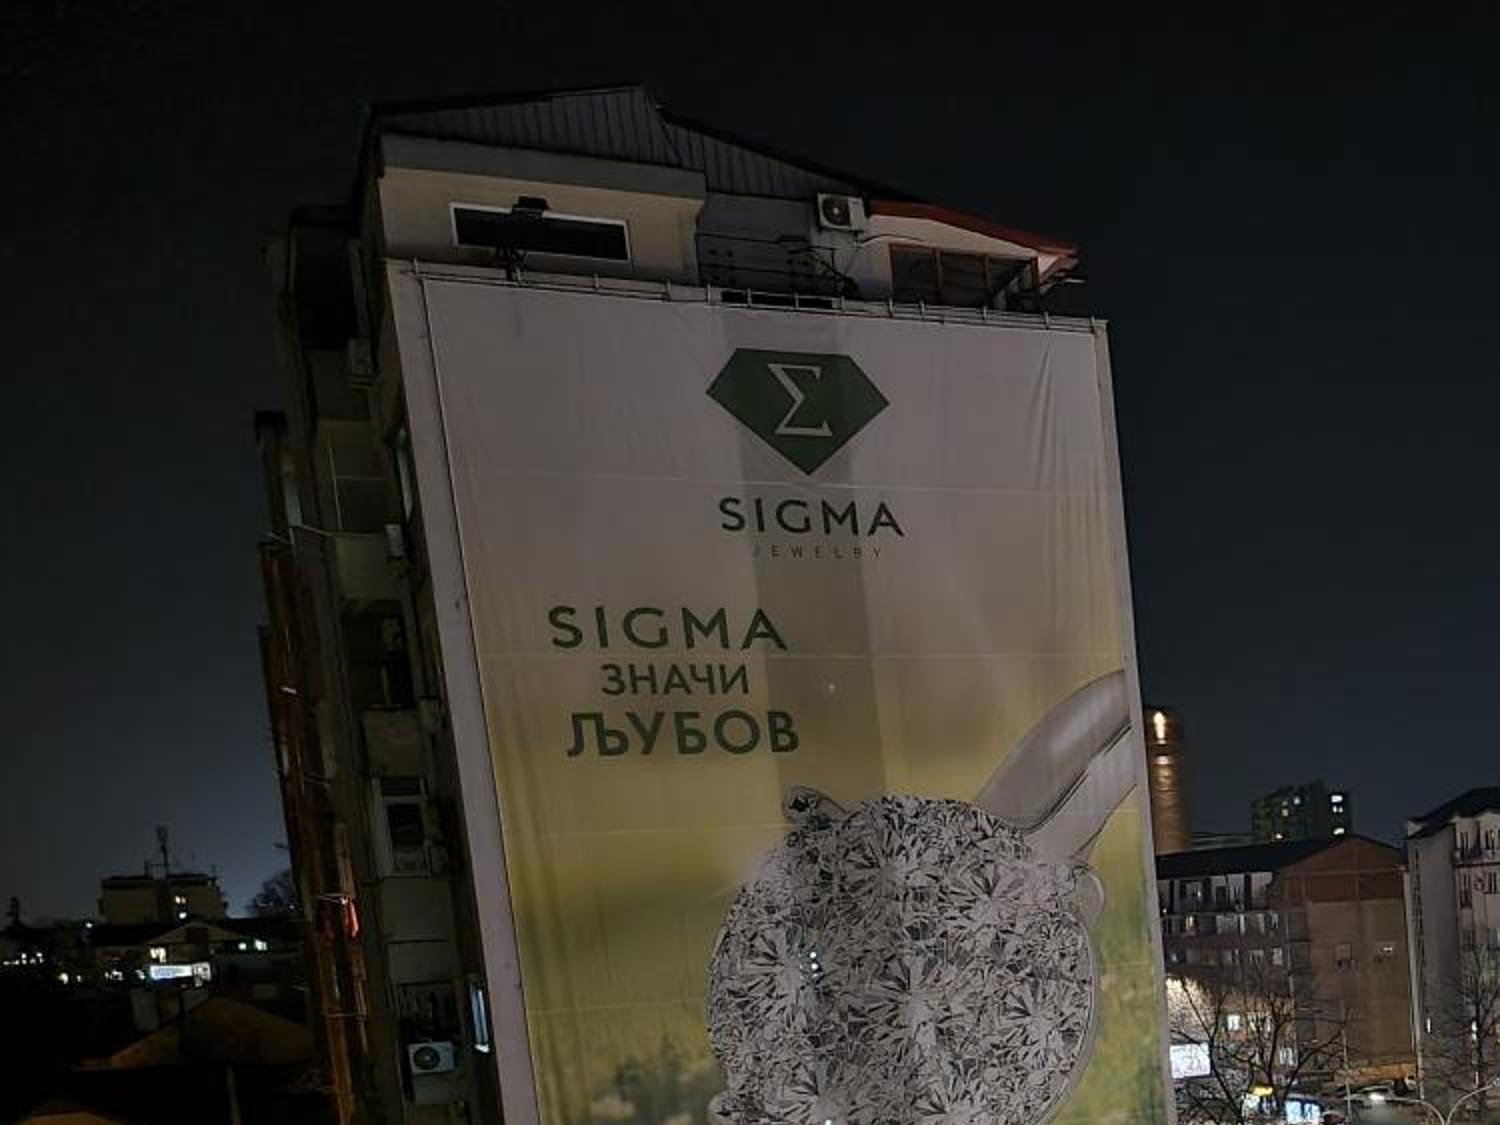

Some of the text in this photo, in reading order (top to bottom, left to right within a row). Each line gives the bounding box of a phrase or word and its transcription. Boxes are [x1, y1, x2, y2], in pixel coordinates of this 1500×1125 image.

[719, 496, 905, 537] SIGMA
[547, 605, 788, 651] SIGMA
[600, 663, 749, 696] ЗНАЧИ
[566, 709, 799, 758] ЉУБОВ
